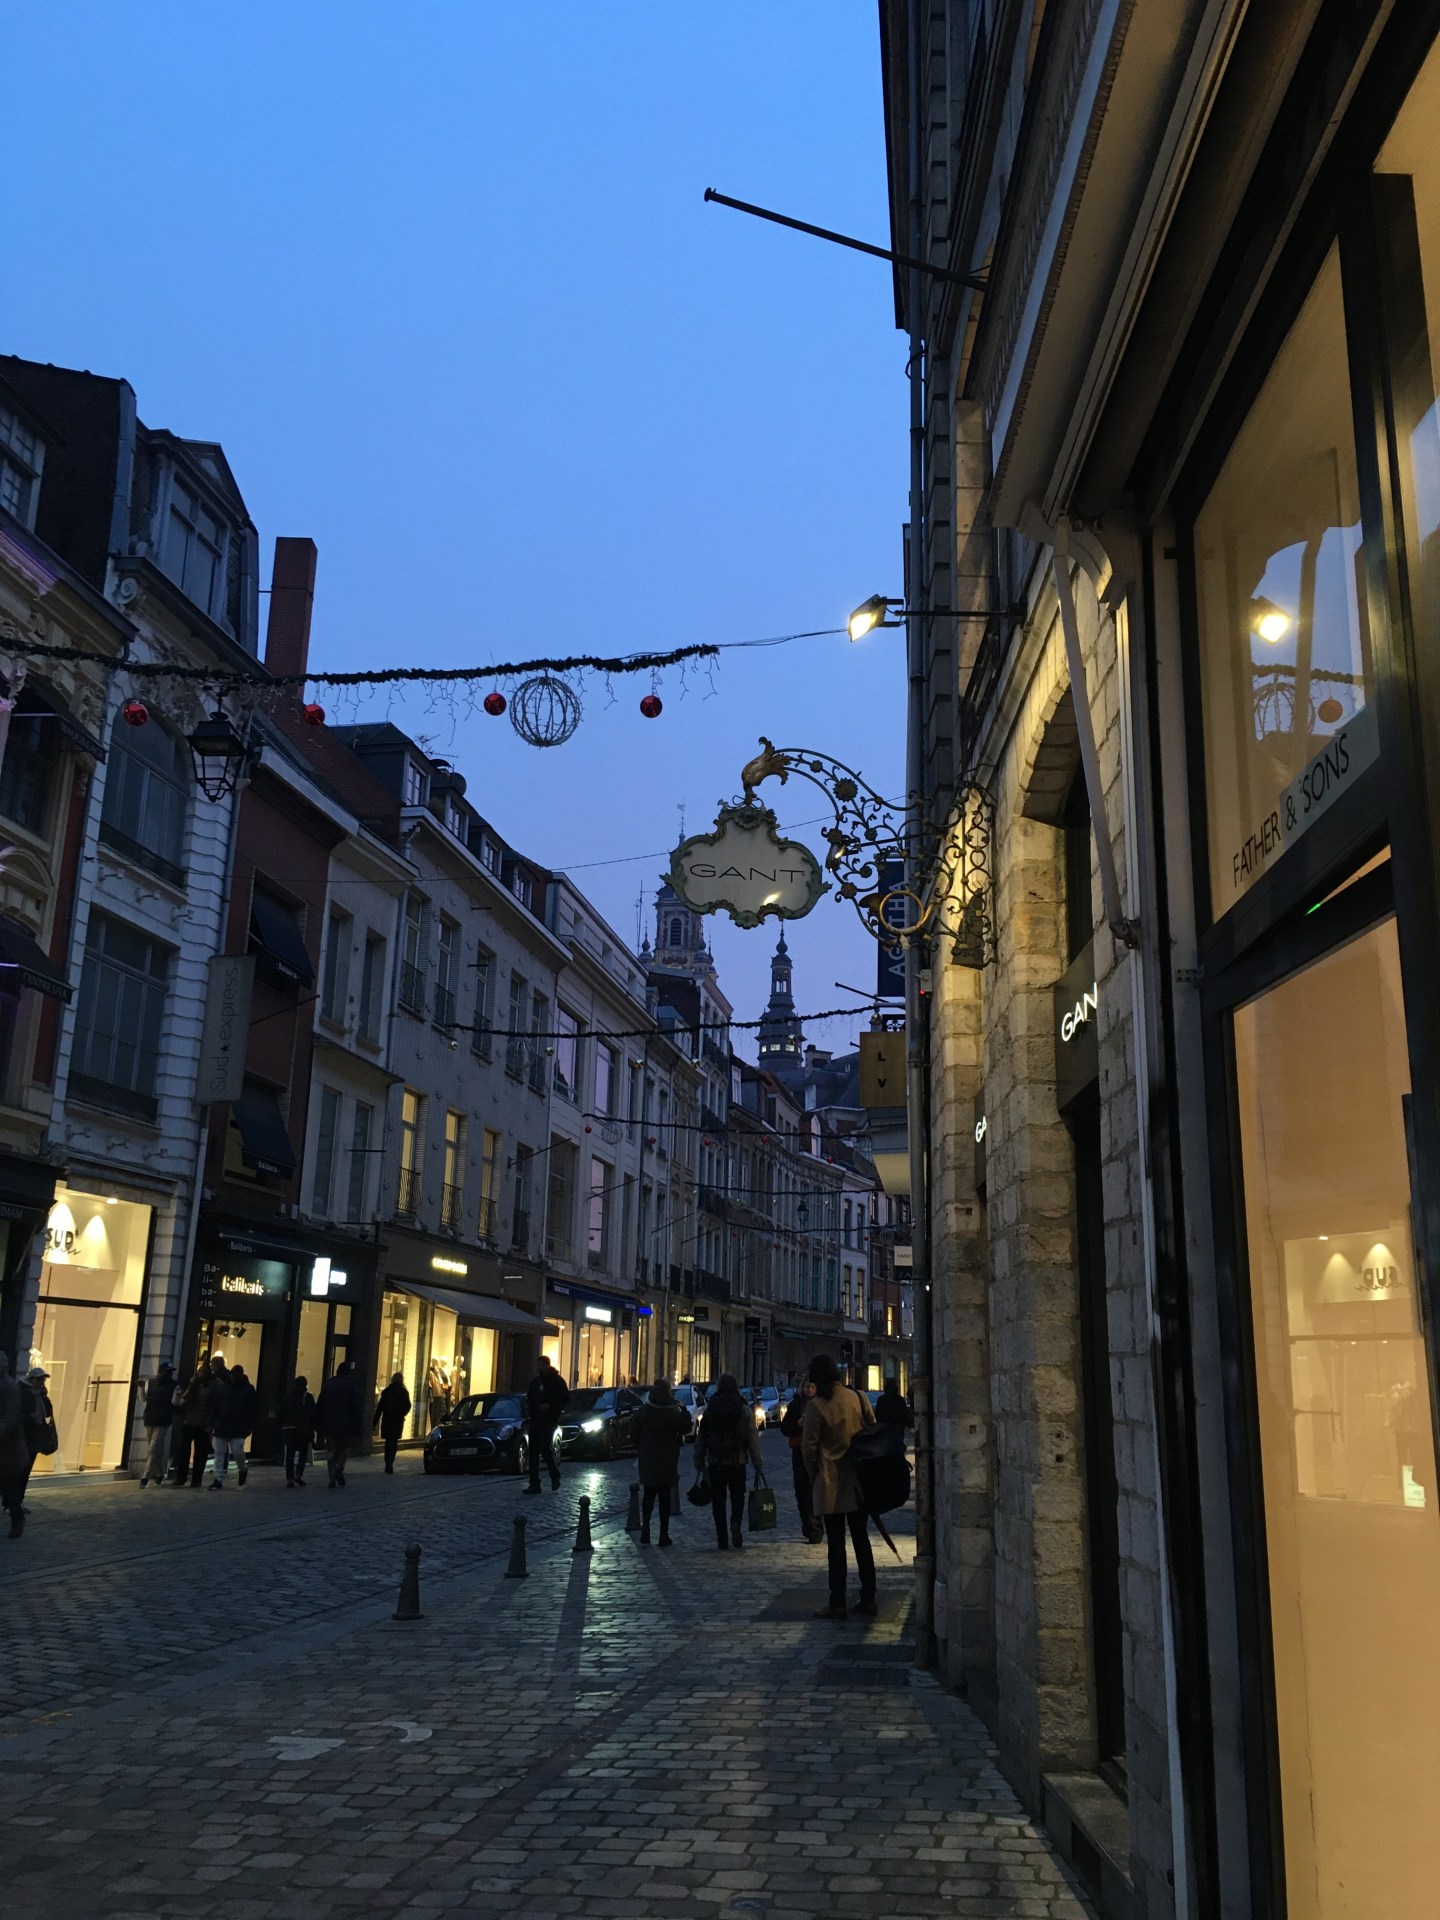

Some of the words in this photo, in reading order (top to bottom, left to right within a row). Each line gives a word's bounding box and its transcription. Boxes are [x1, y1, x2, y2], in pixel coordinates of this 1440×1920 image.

[1233, 811, 1281, 888] FATHER
[1286, 795, 1297, 831] &
[1302, 733, 1350, 813] SONS
[689, 864, 804, 883] GANT
[888, 881, 906, 978] AGTHA
[1061, 982, 1098, 1042] GAN
[877, 1052, 886, 1061] L
